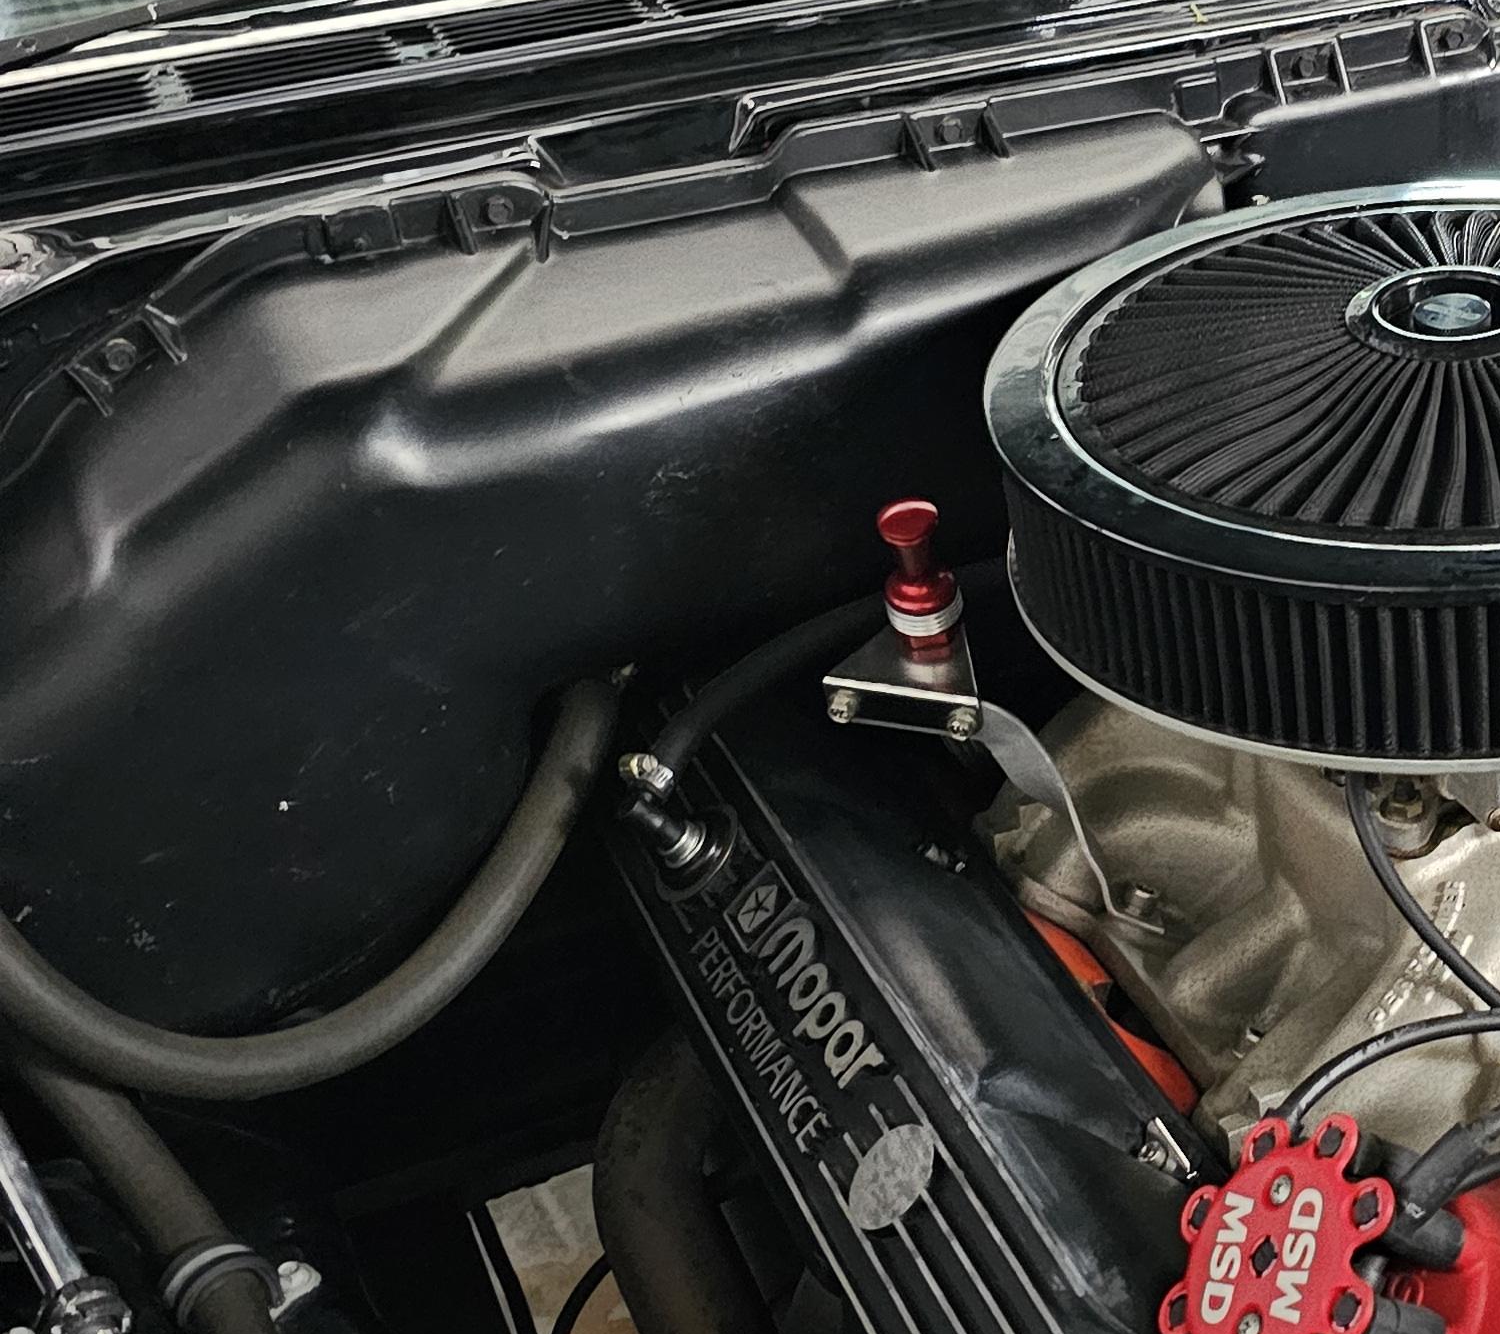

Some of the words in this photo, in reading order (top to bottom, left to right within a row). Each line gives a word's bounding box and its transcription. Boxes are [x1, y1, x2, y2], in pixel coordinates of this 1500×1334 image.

[691, 924, 833, 1155] PERFORMANCE
[1200, 1190, 1255, 1325] MSD
[1269, 1186, 1325, 1325] MSD
